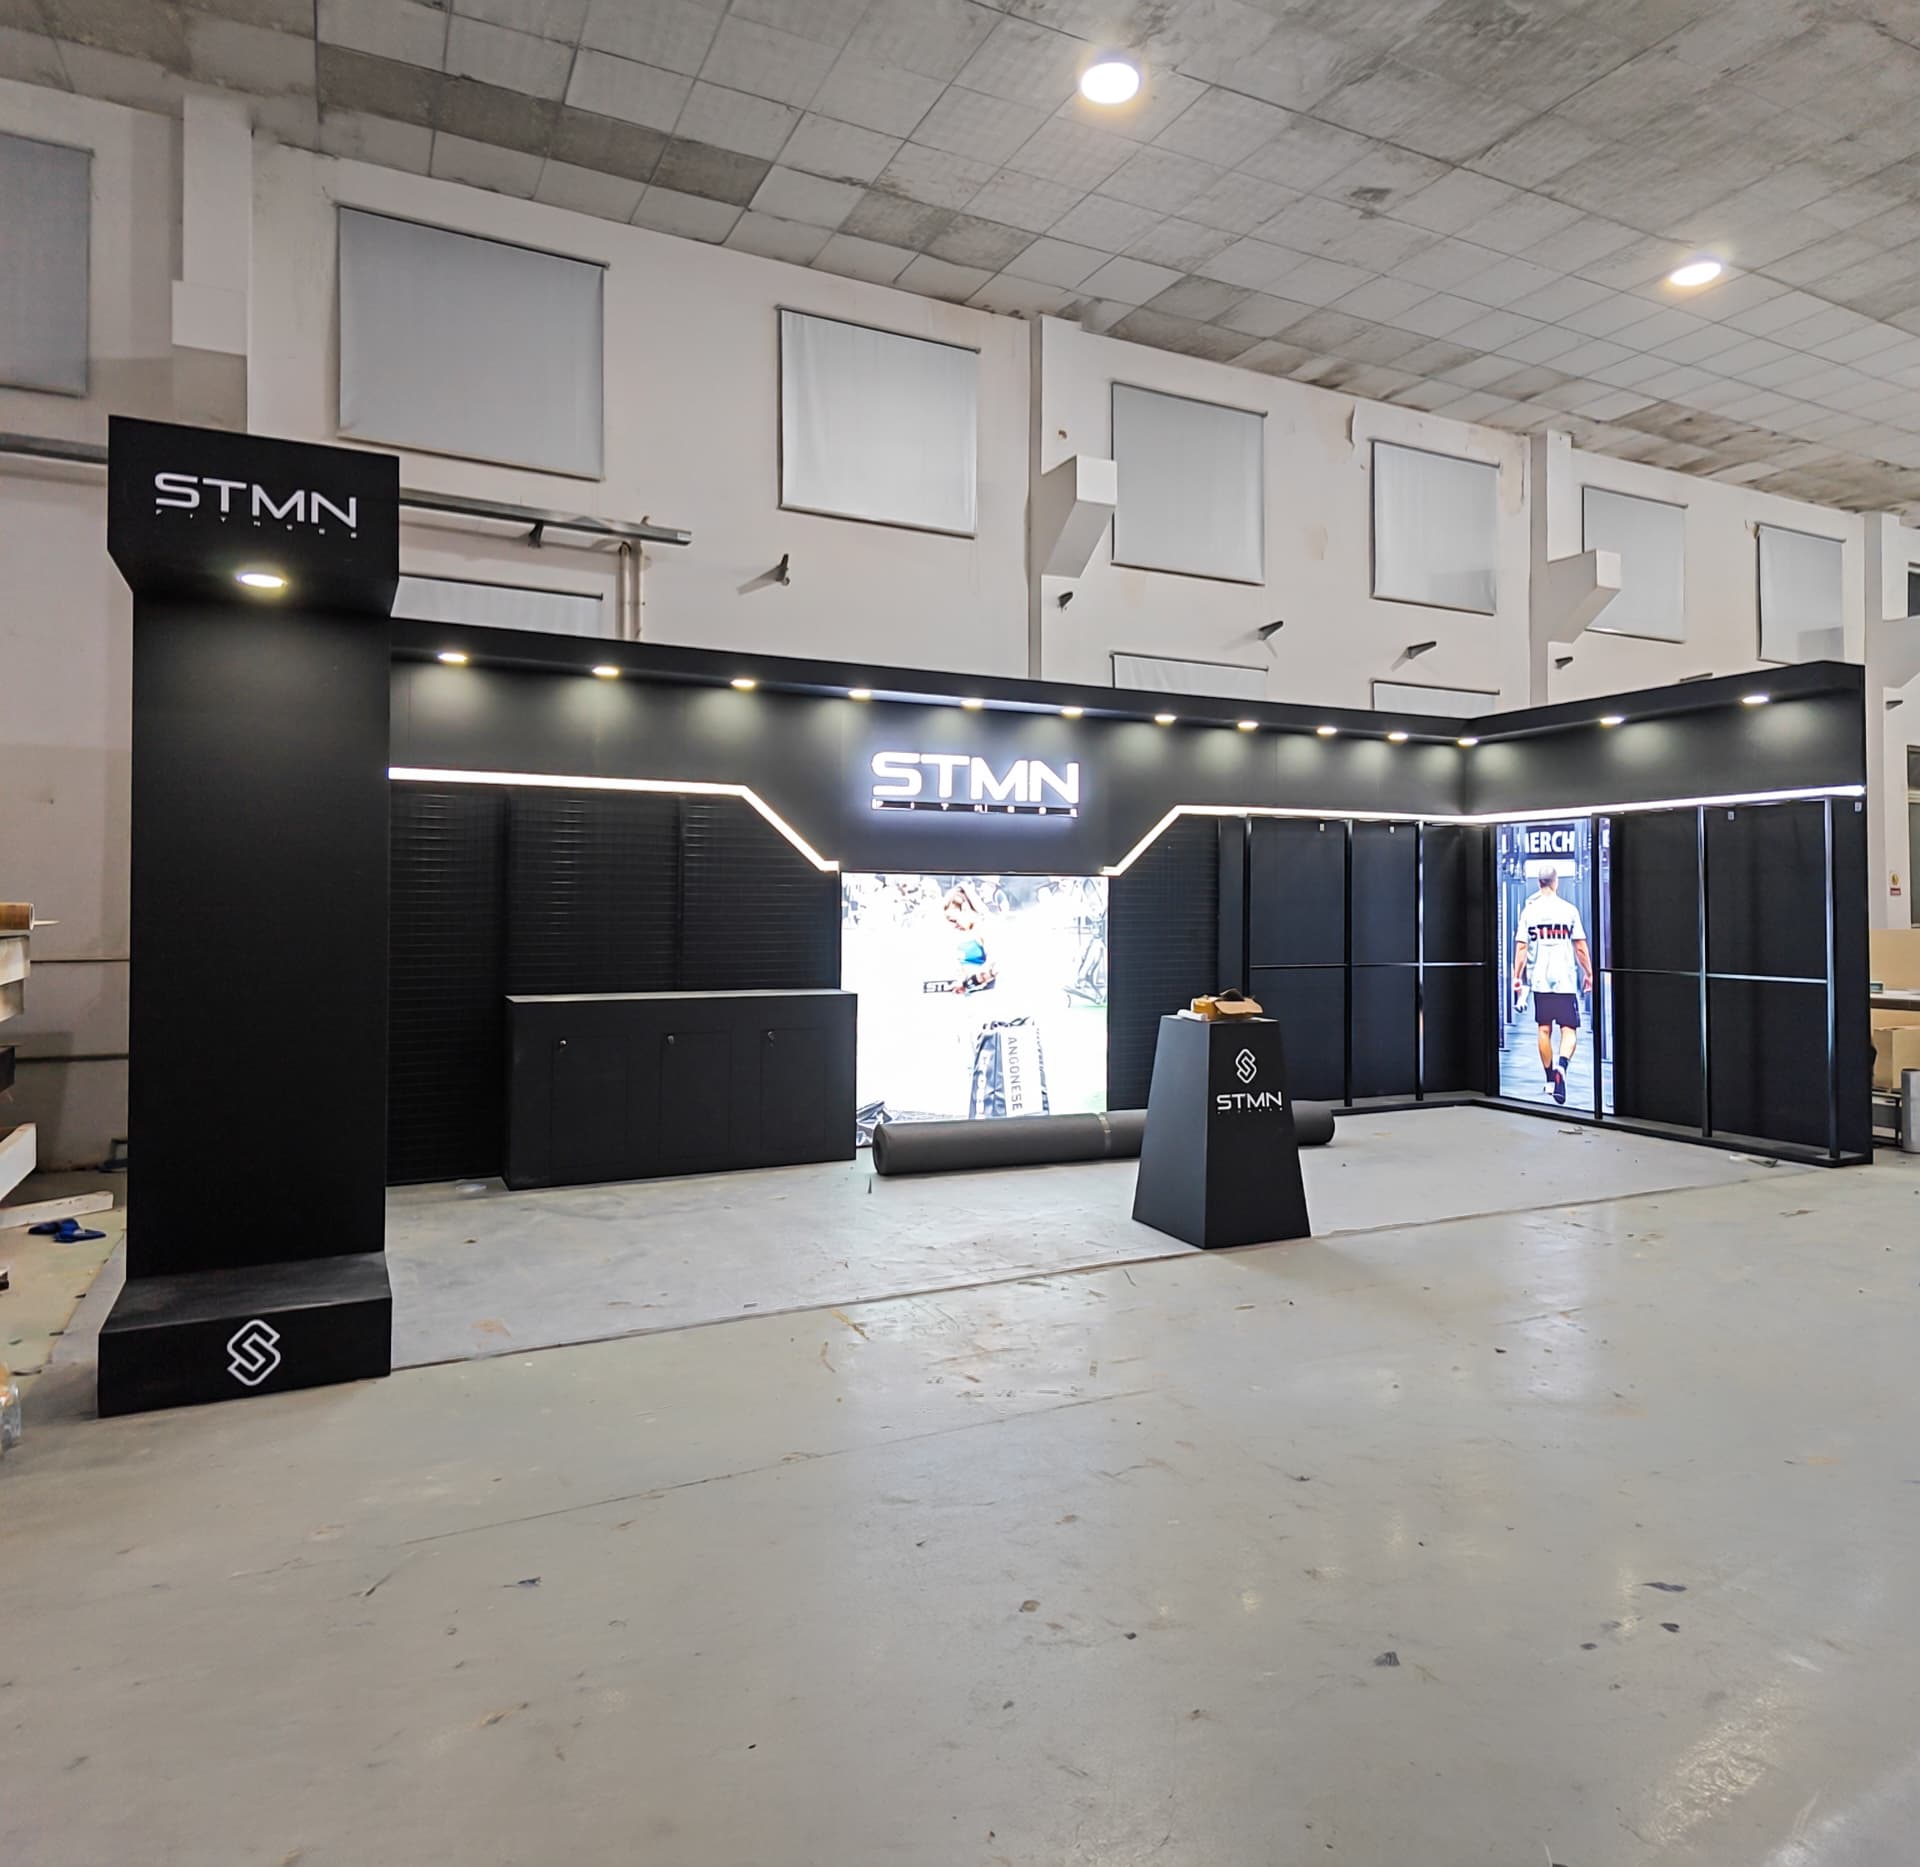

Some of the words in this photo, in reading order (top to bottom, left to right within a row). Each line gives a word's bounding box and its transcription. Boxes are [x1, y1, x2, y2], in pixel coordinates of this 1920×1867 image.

[154, 471, 357, 528] STMN
[871, 751, 1080, 804] STMN
[1528, 924, 1574, 942] STMN
[1216, 1091, 1282, 1110] STMN
